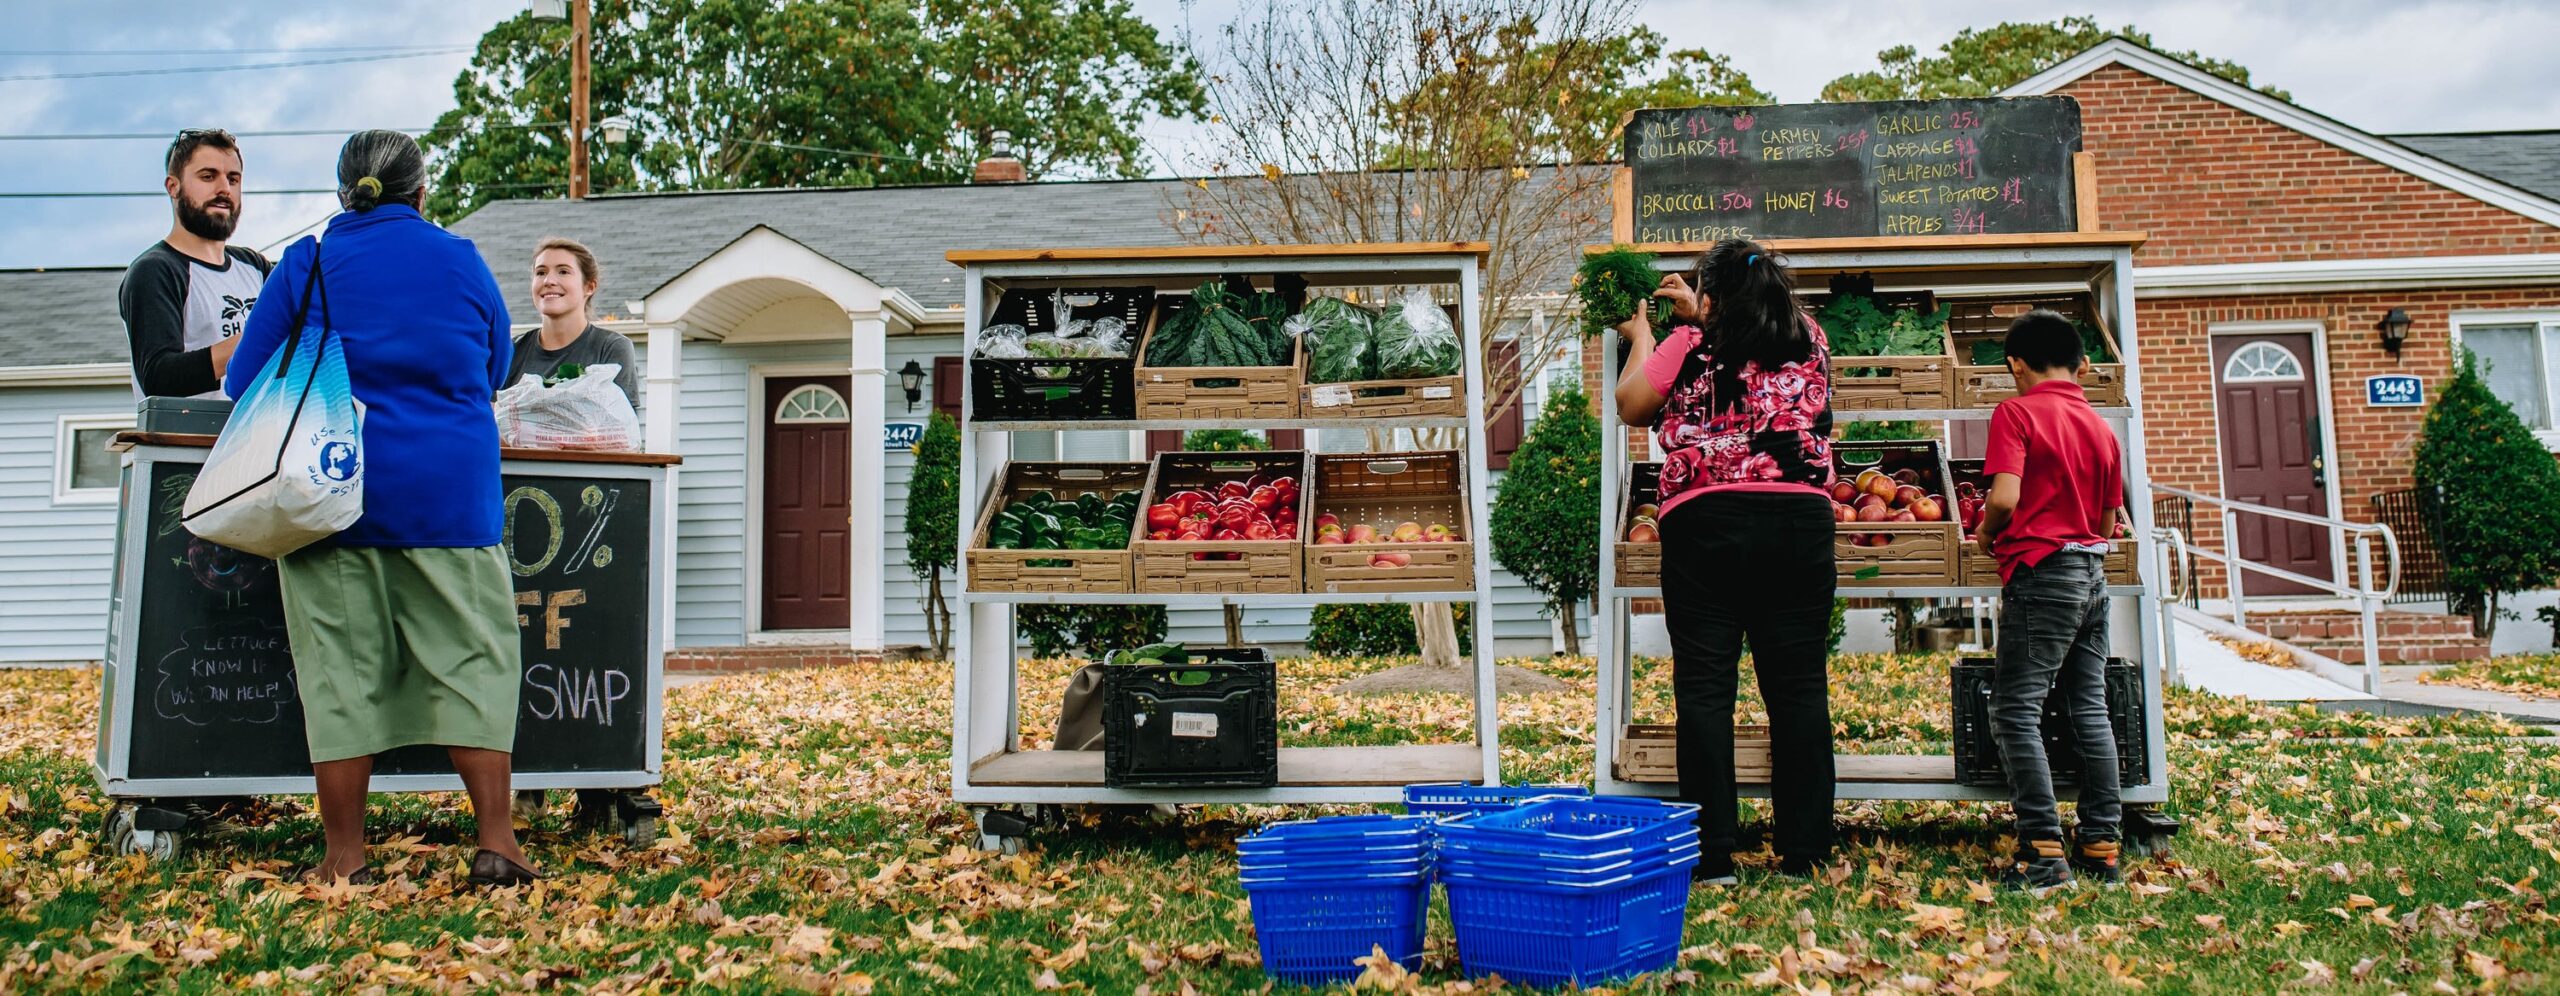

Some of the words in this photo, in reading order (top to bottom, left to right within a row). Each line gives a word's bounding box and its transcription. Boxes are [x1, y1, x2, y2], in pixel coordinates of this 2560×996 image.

[1642, 121, 1681, 141] KALE
[1687, 116, 1714, 138] $1
[1876, 115, 1942, 136] GARLIC
[1762, 128, 1821, 145] CARMEN
[1637, 140, 1717, 161] COLLARDS
[1718, 137, 1739, 157] $1
[1763, 143, 1834, 162] PEPPERS
[1873, 139, 1954, 159] CABBAGE
[1954, 136, 1980, 155] $1
[1874, 162, 1958, 186] JALAPENOS
[1958, 158, 1975, 180] $1
[1765, 191, 1816, 214] HONEY
[1822, 188, 1849, 209] $6
[1879, 187, 1932, 206] SWEET
[2001, 176, 2023, 204] $1
[1642, 194, 1716, 218] BROCCOLI
[1886, 214, 1944, 235] APPLES
[2375, 379, 2416, 395] 2443
[884, 427, 918, 441] 2447
[203, 636, 278, 651] LETTUCE
[191, 657, 241, 677] KNOW
[237, 681, 279, 701] HELP!
[525, 663, 631, 727] SNAP
